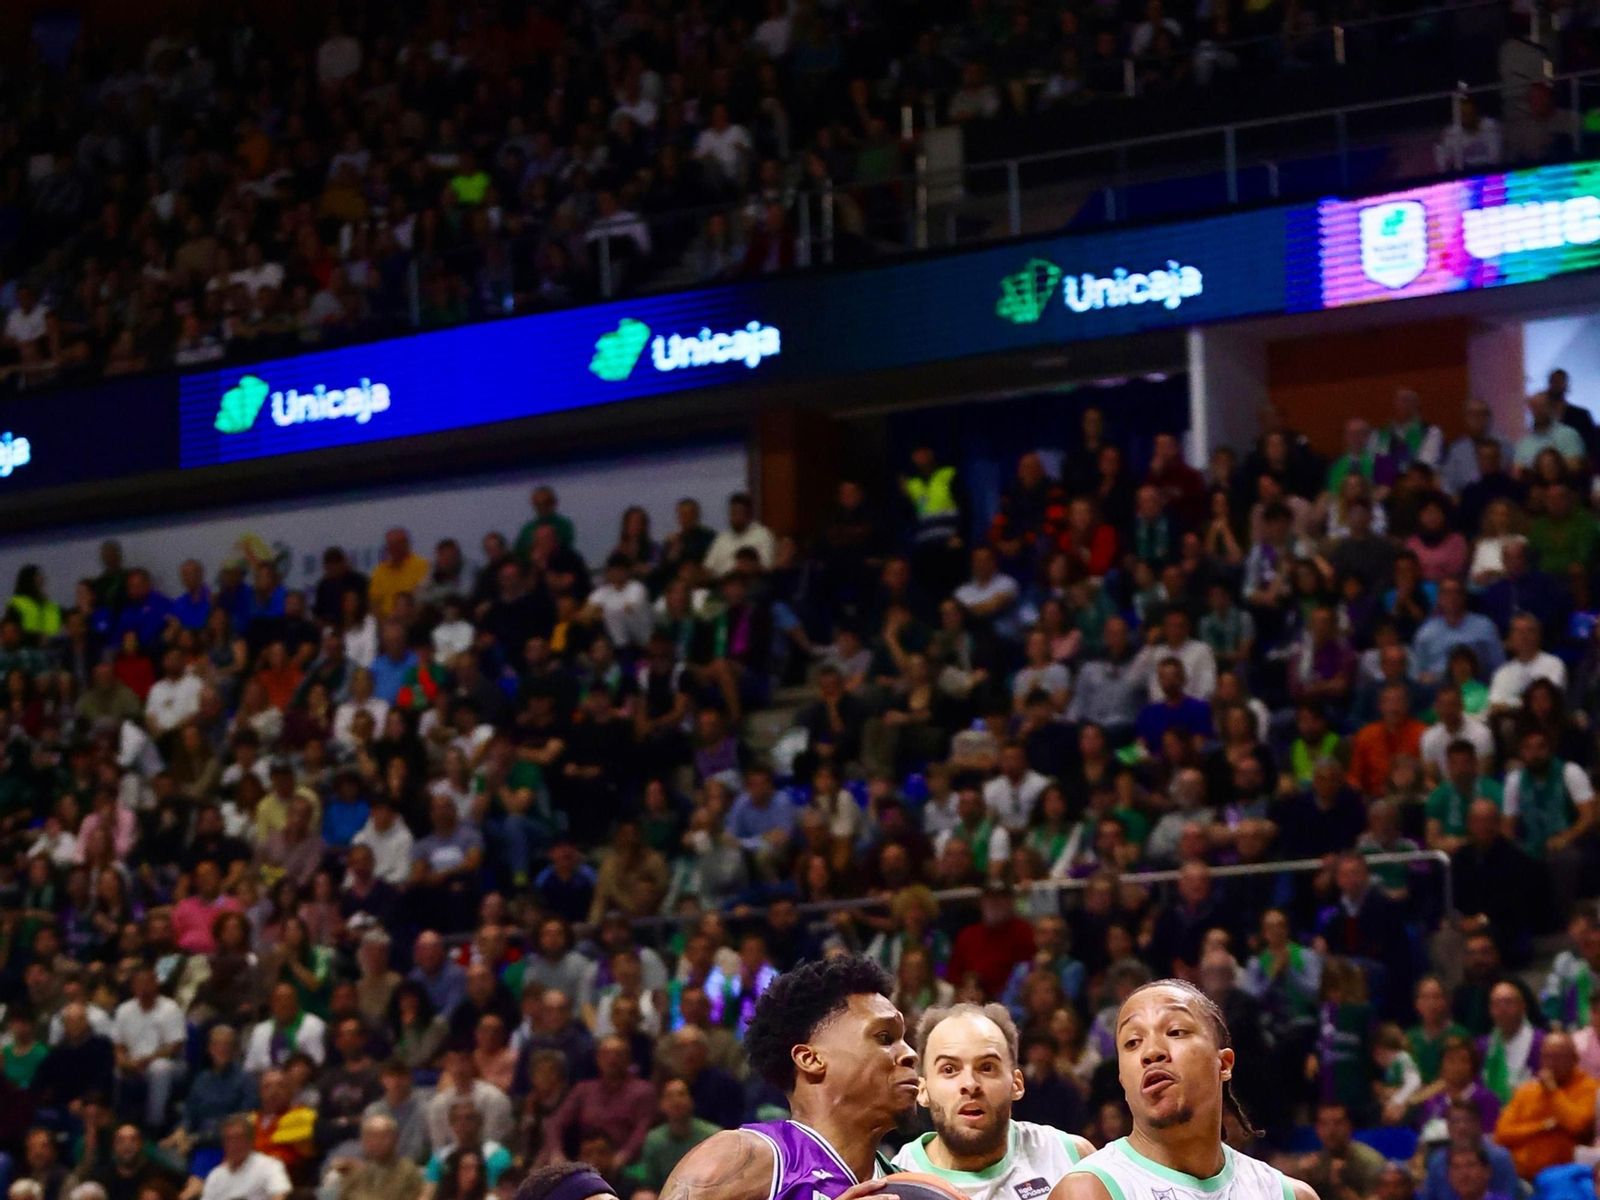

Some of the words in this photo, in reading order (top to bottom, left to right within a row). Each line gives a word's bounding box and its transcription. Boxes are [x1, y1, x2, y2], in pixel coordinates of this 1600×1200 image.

[1063, 259, 1203, 313] Unicaja
[651, 320, 781, 372] Unicaja
[270, 377, 391, 427] Unicaja
